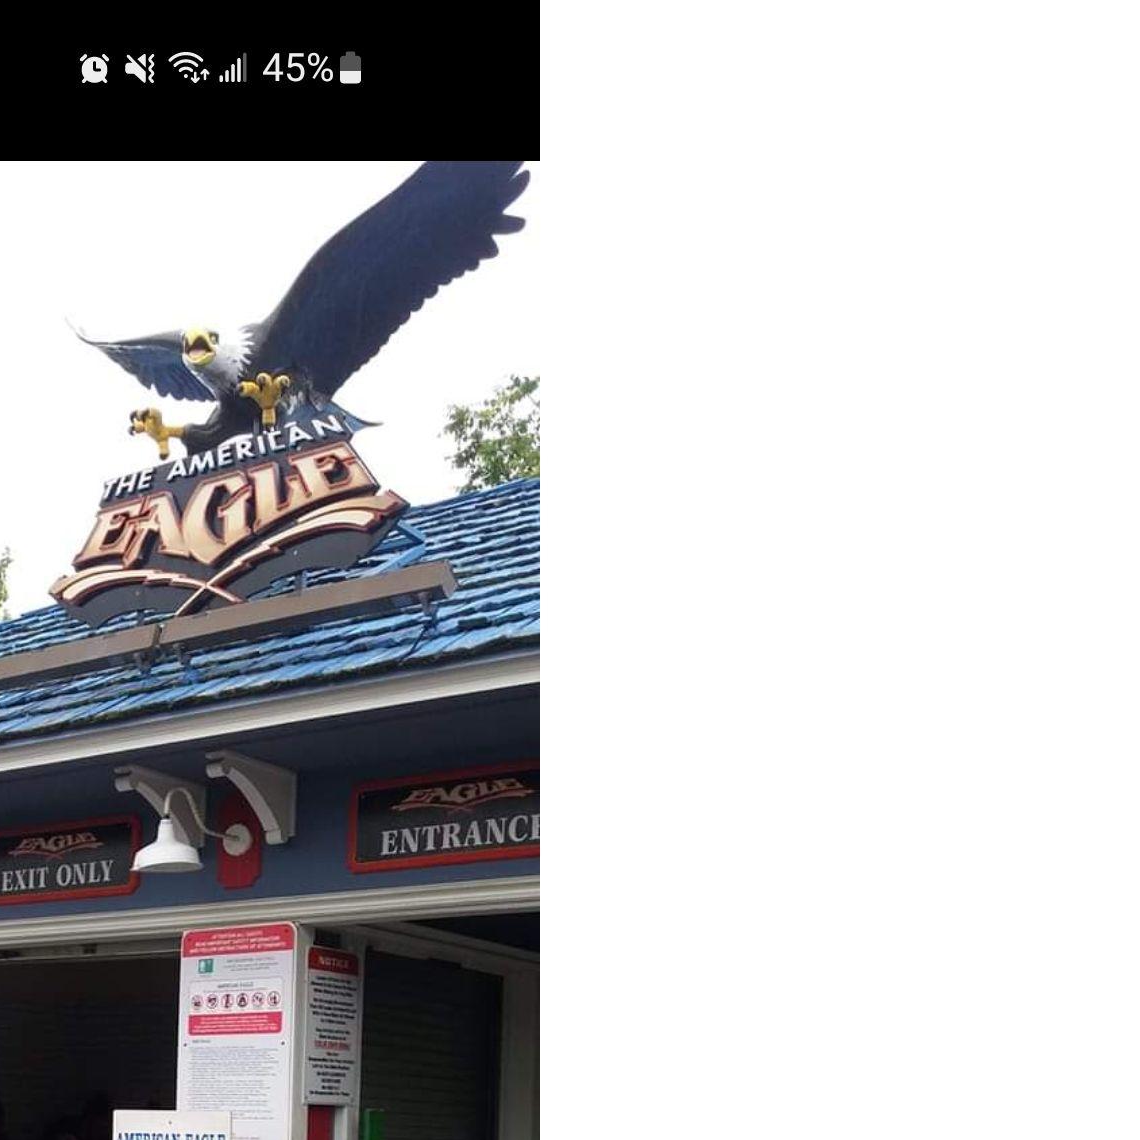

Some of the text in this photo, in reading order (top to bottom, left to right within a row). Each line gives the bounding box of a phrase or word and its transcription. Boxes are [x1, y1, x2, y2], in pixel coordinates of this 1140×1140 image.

[102, 414, 346, 499] THE AMERICAN
[73, 441, 381, 570] EAGLE
[401, 778, 525, 803] EAGLE
[1, 860, 114, 892] EXIT ONLY
